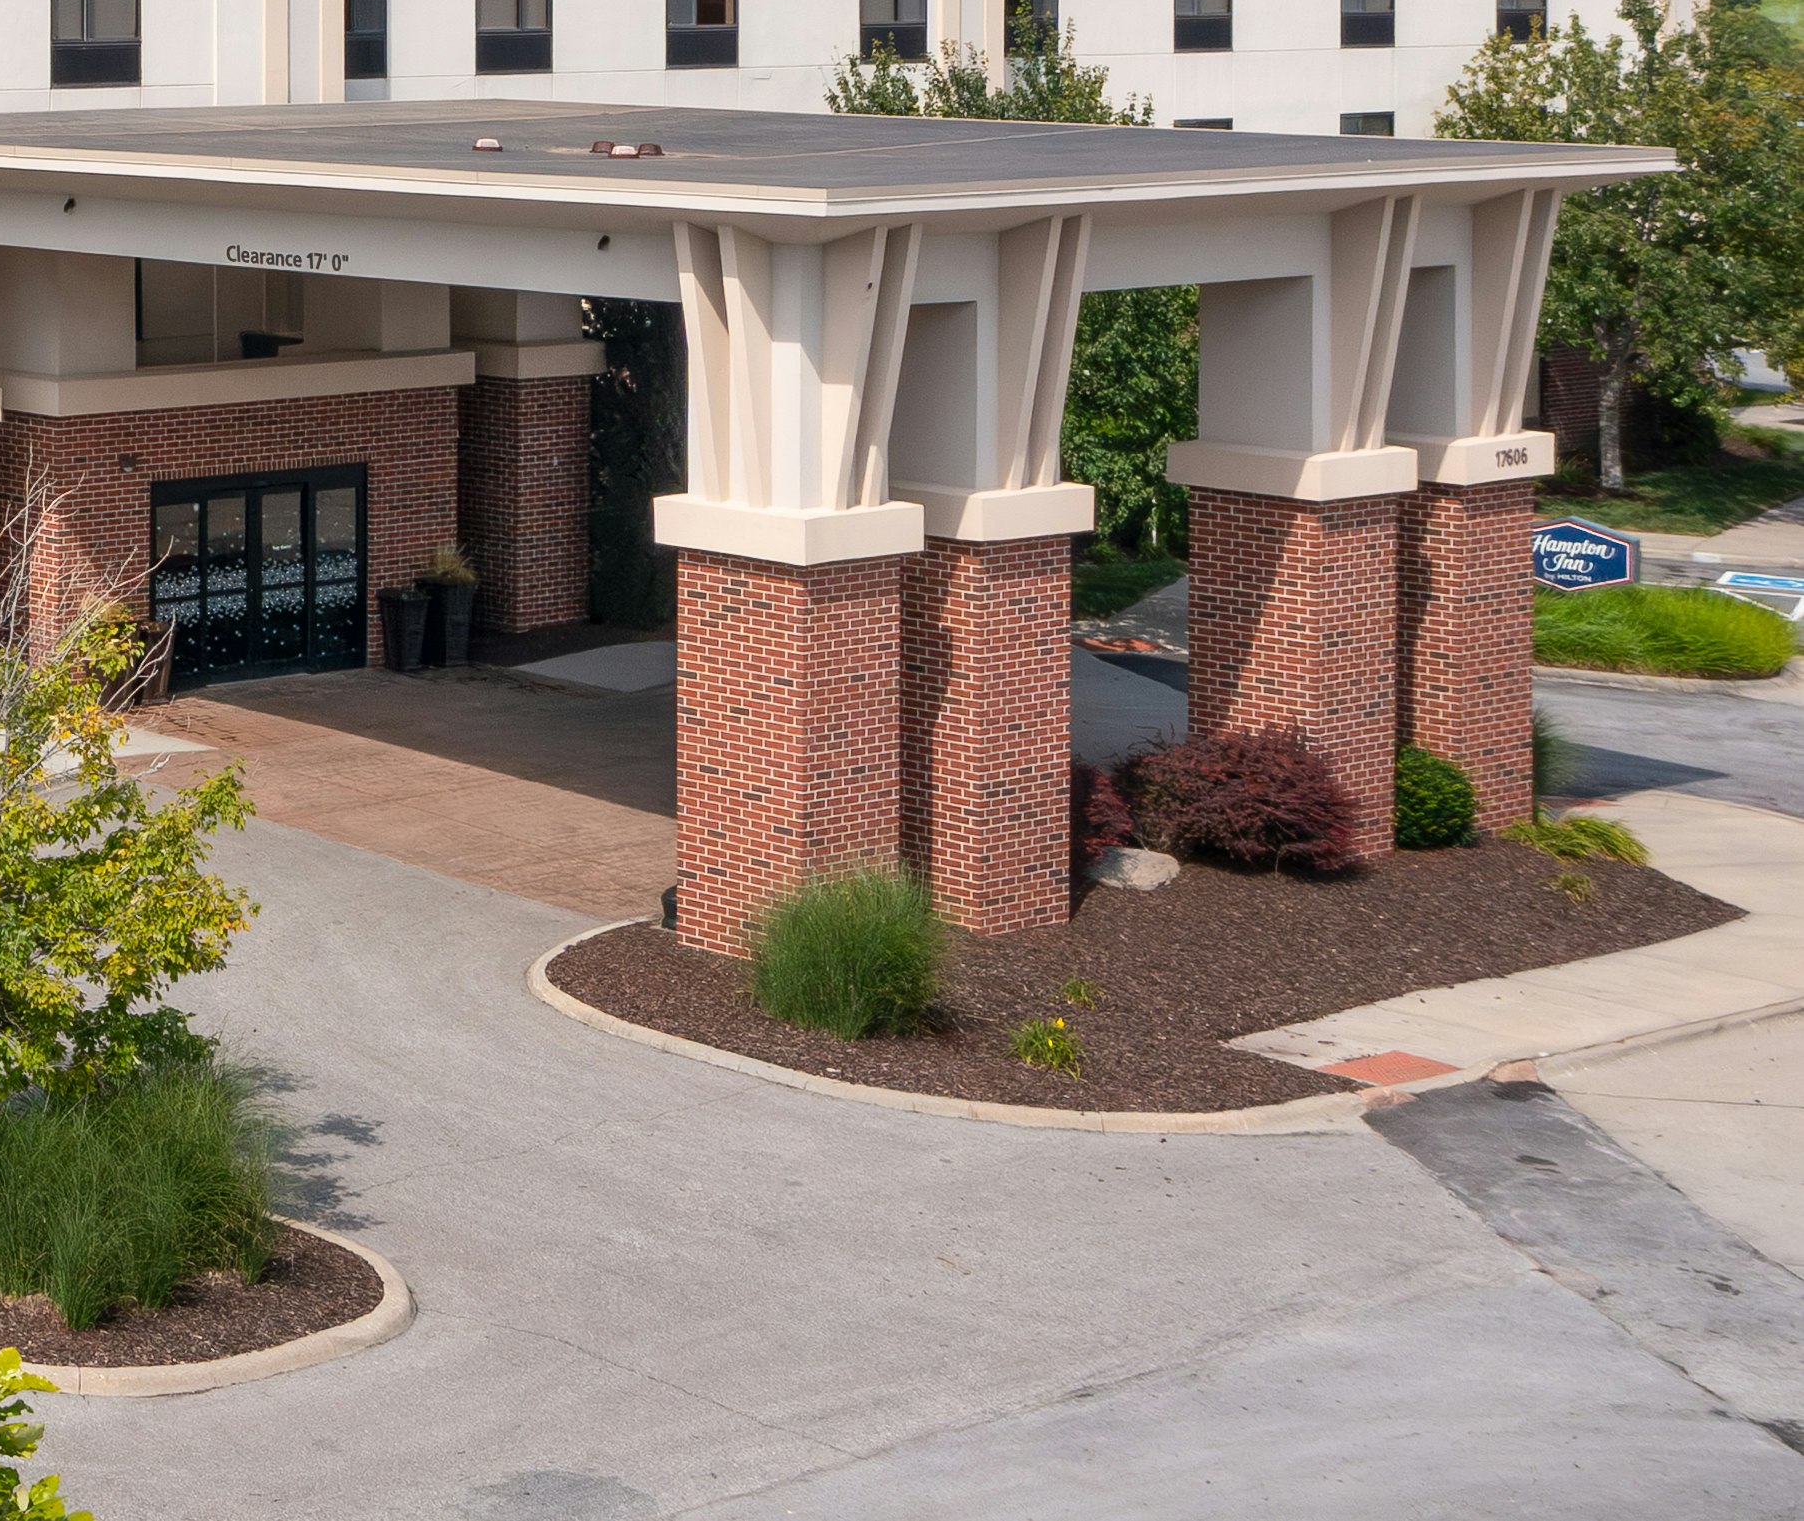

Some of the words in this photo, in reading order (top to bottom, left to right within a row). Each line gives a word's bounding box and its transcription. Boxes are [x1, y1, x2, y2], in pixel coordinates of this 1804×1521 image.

[226, 245, 302, 268] Clearance
[306, 252, 327, 270] 17'
[331, 254, 349, 272] 0"
[1495, 447, 1528, 468] 17606
[1532, 534, 1615, 559] Hampton
[1543, 553, 1593, 573] Inn
[1557, 572, 1591, 582] HILTON
